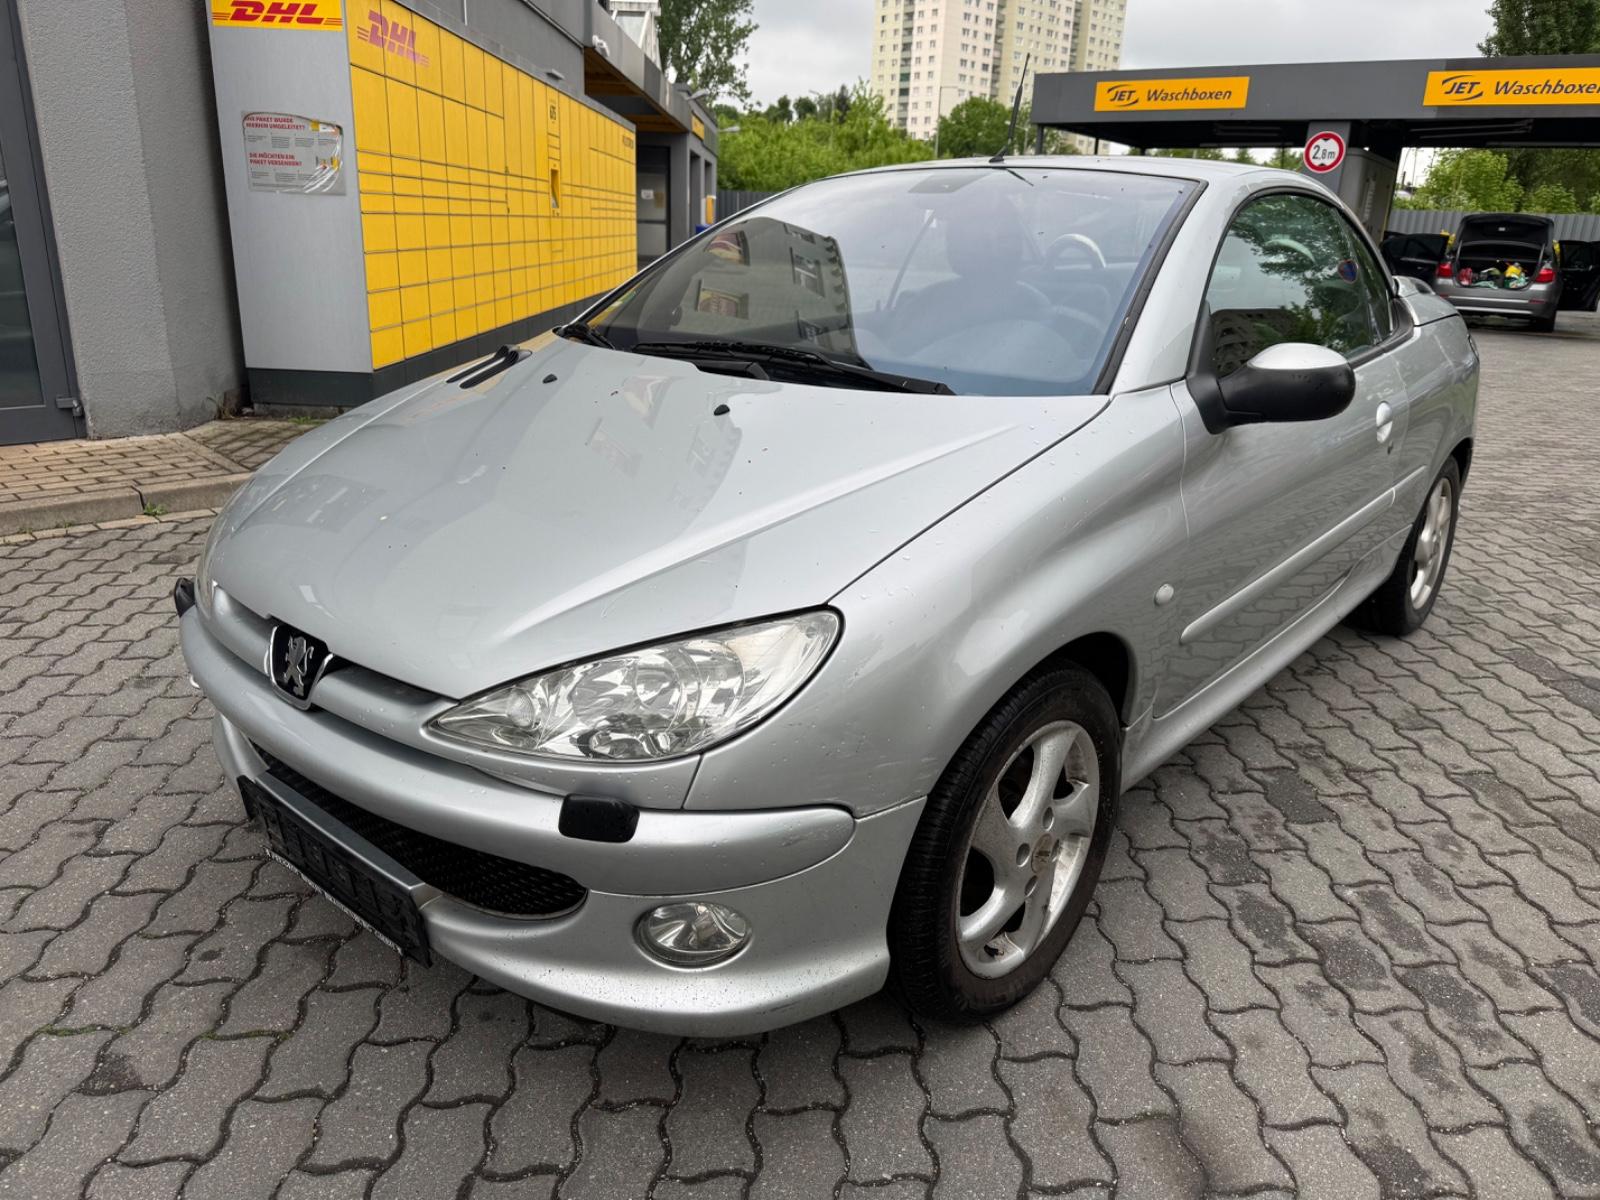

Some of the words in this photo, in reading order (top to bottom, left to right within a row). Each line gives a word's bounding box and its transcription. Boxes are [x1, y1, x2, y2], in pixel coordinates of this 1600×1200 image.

[230, 0, 324, 25] DHL
[368, 10, 421, 63] DHL
[1147, 88, 1232, 102] Waschboxen
